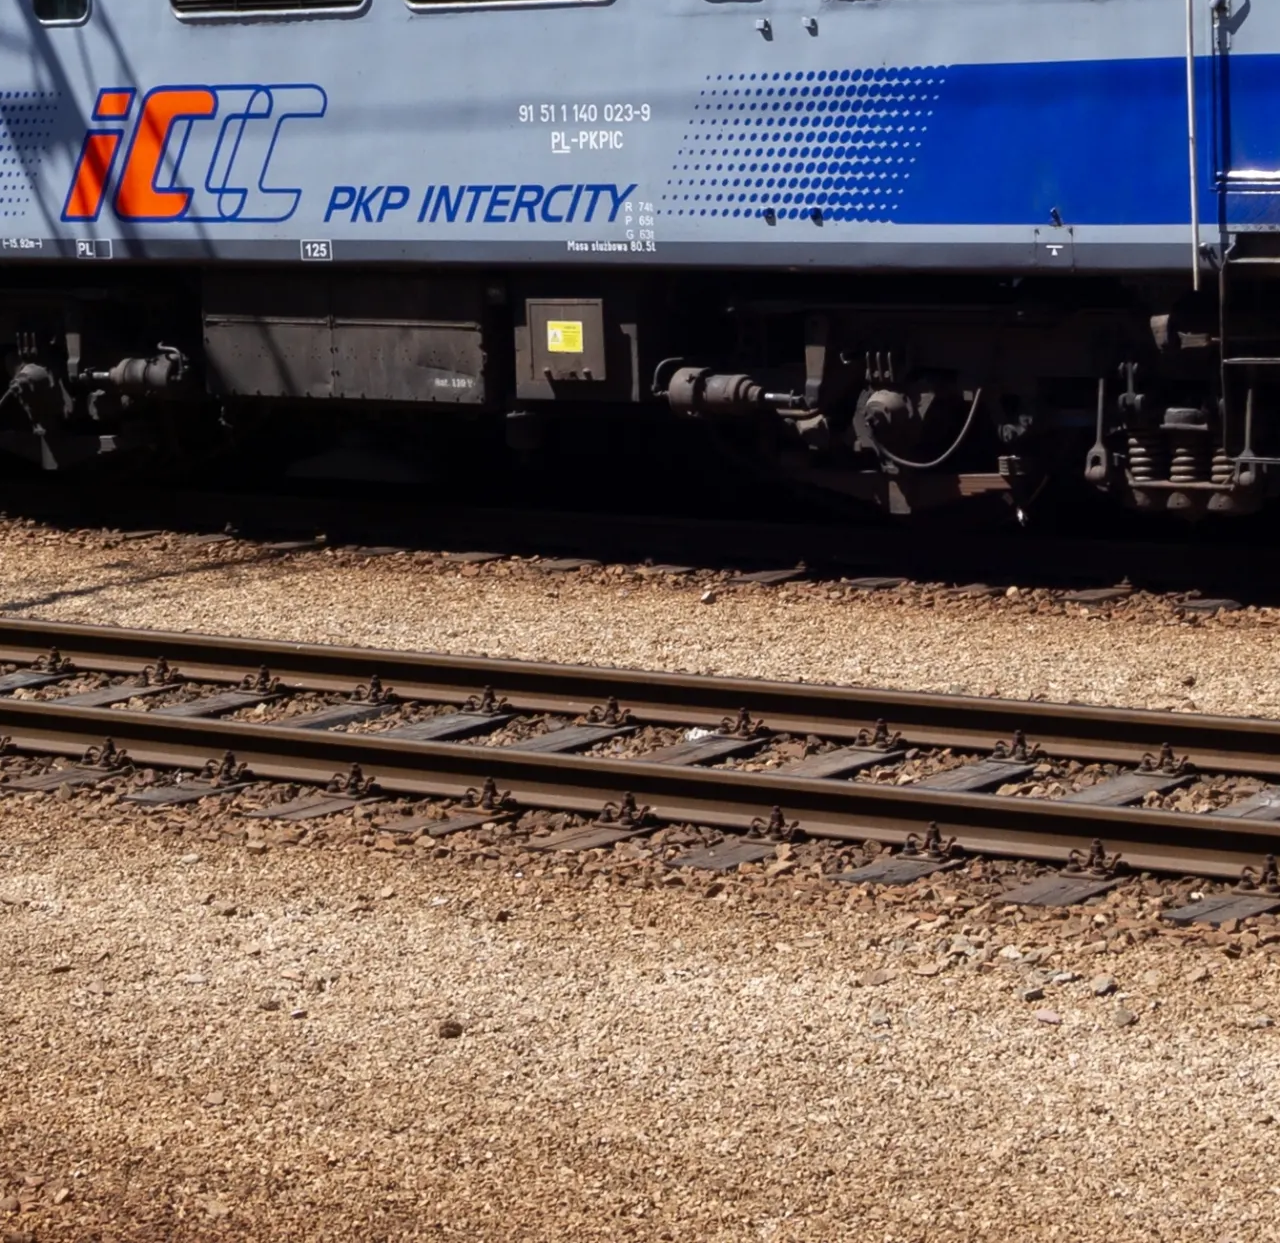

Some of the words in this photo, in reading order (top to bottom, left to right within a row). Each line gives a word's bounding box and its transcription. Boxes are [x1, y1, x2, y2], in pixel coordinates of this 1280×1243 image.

[518, 104, 534, 122] 91
[540, 104, 555, 122] 51
[603, 103, 651, 122] 023-9
[551, 130, 624, 154] PL-PKPIC
[323, 185, 411, 224] PKP
[417, 183, 638, 224] INTERCITY
[624, 202, 633, 212] R
[625, 215, 633, 226] P
[625, 229, 635, 240] G
[78, 241, 94, 256] PL
[305, 243, 327, 257] 125
[567, 240, 589, 252] Masa
